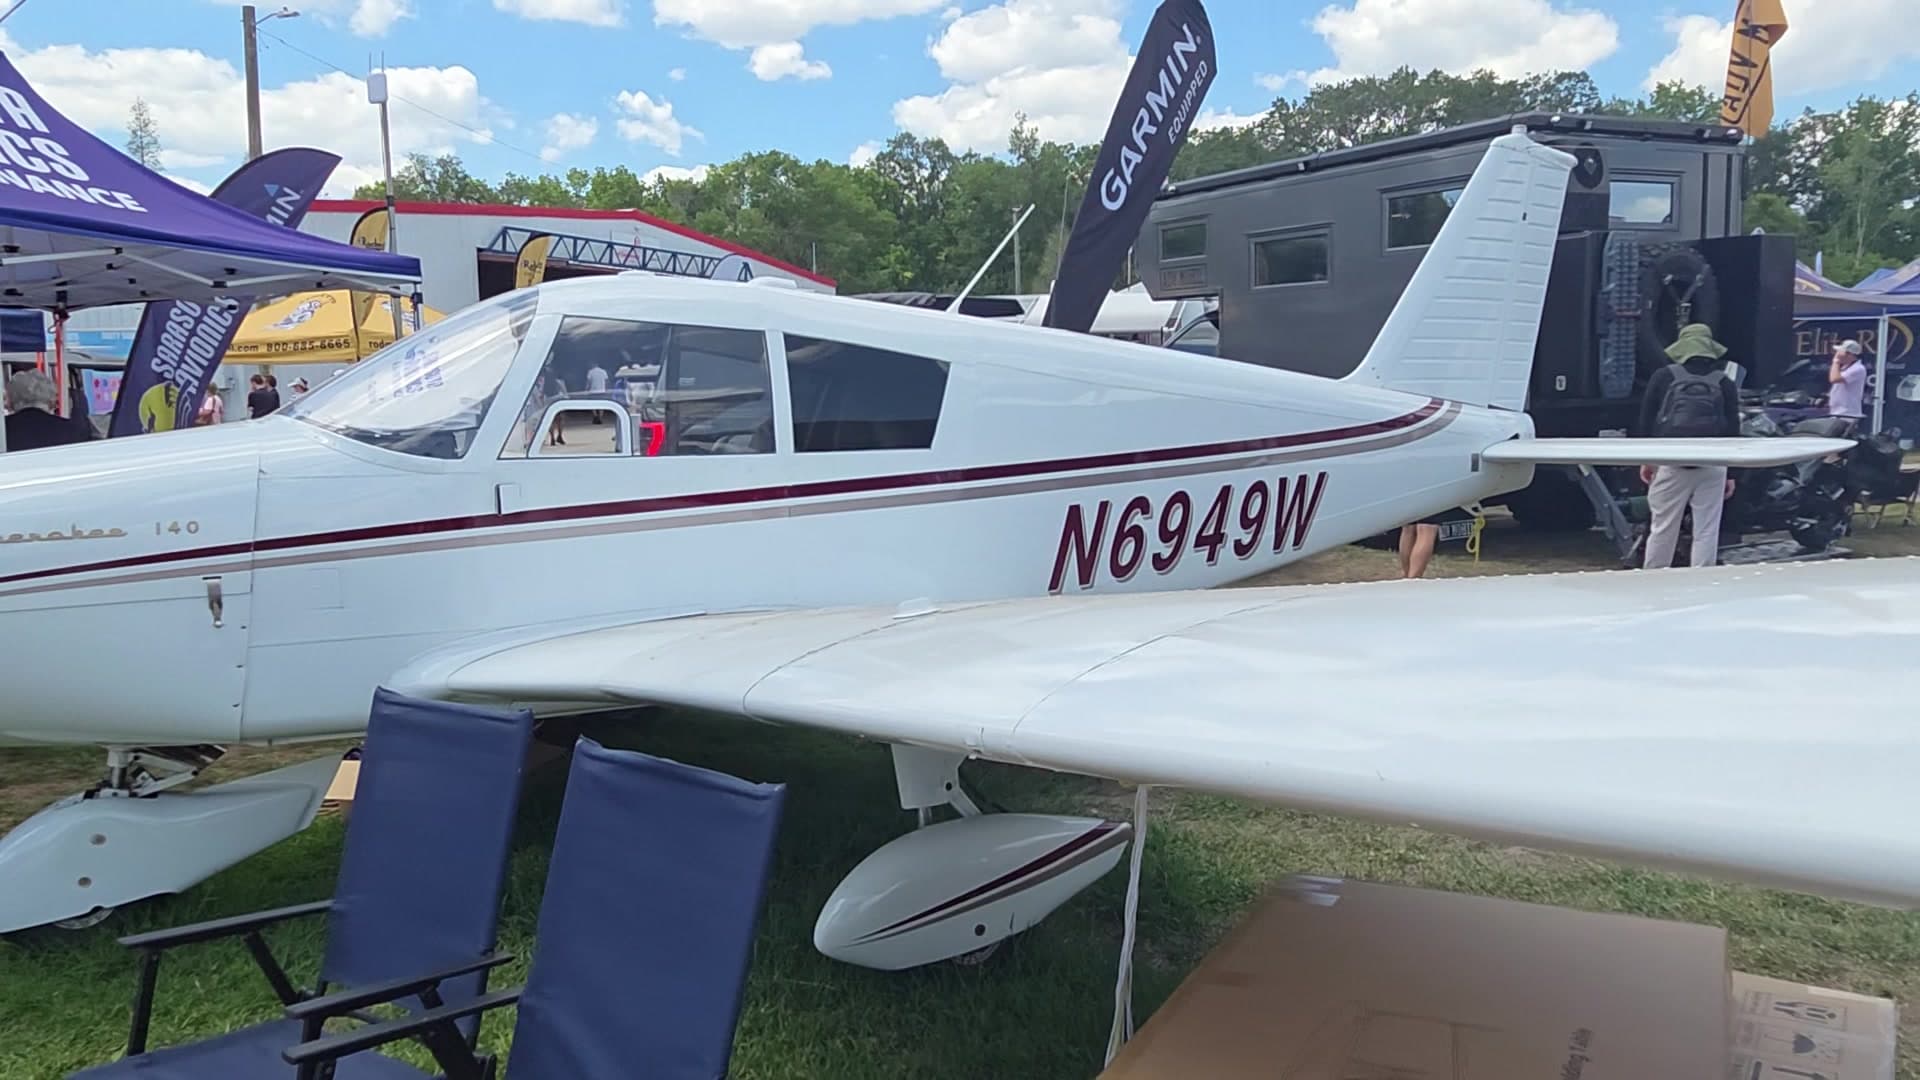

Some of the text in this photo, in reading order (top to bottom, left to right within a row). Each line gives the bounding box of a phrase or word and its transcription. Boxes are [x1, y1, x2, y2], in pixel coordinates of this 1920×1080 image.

[0, 85, 50, 133] A
[1100, 23, 1199, 211] GARMIN
[1167, 60, 1208, 145] EQUIPPED
[0, 128, 90, 182] CS
[1796, 327, 1840, 355] Elit
[155, 521, 200, 536] 140
[1048, 471, 1328, 595] N6949W
